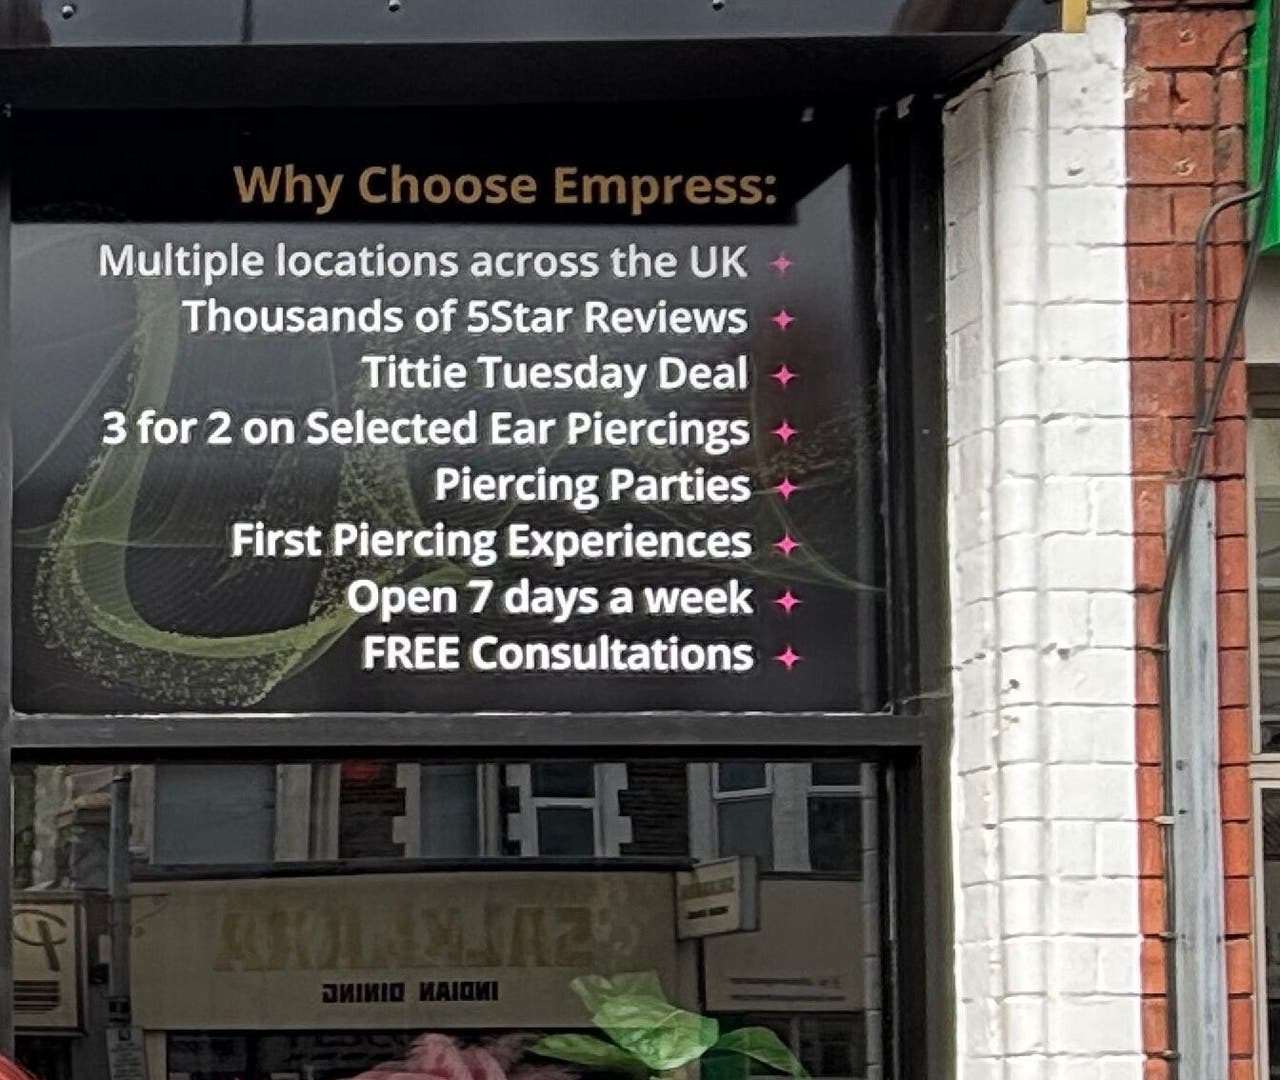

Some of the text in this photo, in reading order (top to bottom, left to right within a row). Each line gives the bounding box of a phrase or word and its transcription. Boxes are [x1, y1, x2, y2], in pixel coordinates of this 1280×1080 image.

[233, 163, 777, 216] Why Choose Empress:
[99, 242, 748, 287] Multiple locations across the UK
[181, 297, 748, 334] Thousands of 5Star Reviews
[360, 354, 747, 399] Tittie Tuesday Deal
[102, 408, 750, 456] 3 for 2 on Selected Ear Piercings
[435, 465, 752, 511] Piercing Parties
[231, 520, 752, 567] First Piercing Experiences
[347, 577, 754, 624] Open 7 days a week
[363, 634, 754, 672] FREE Consultations
